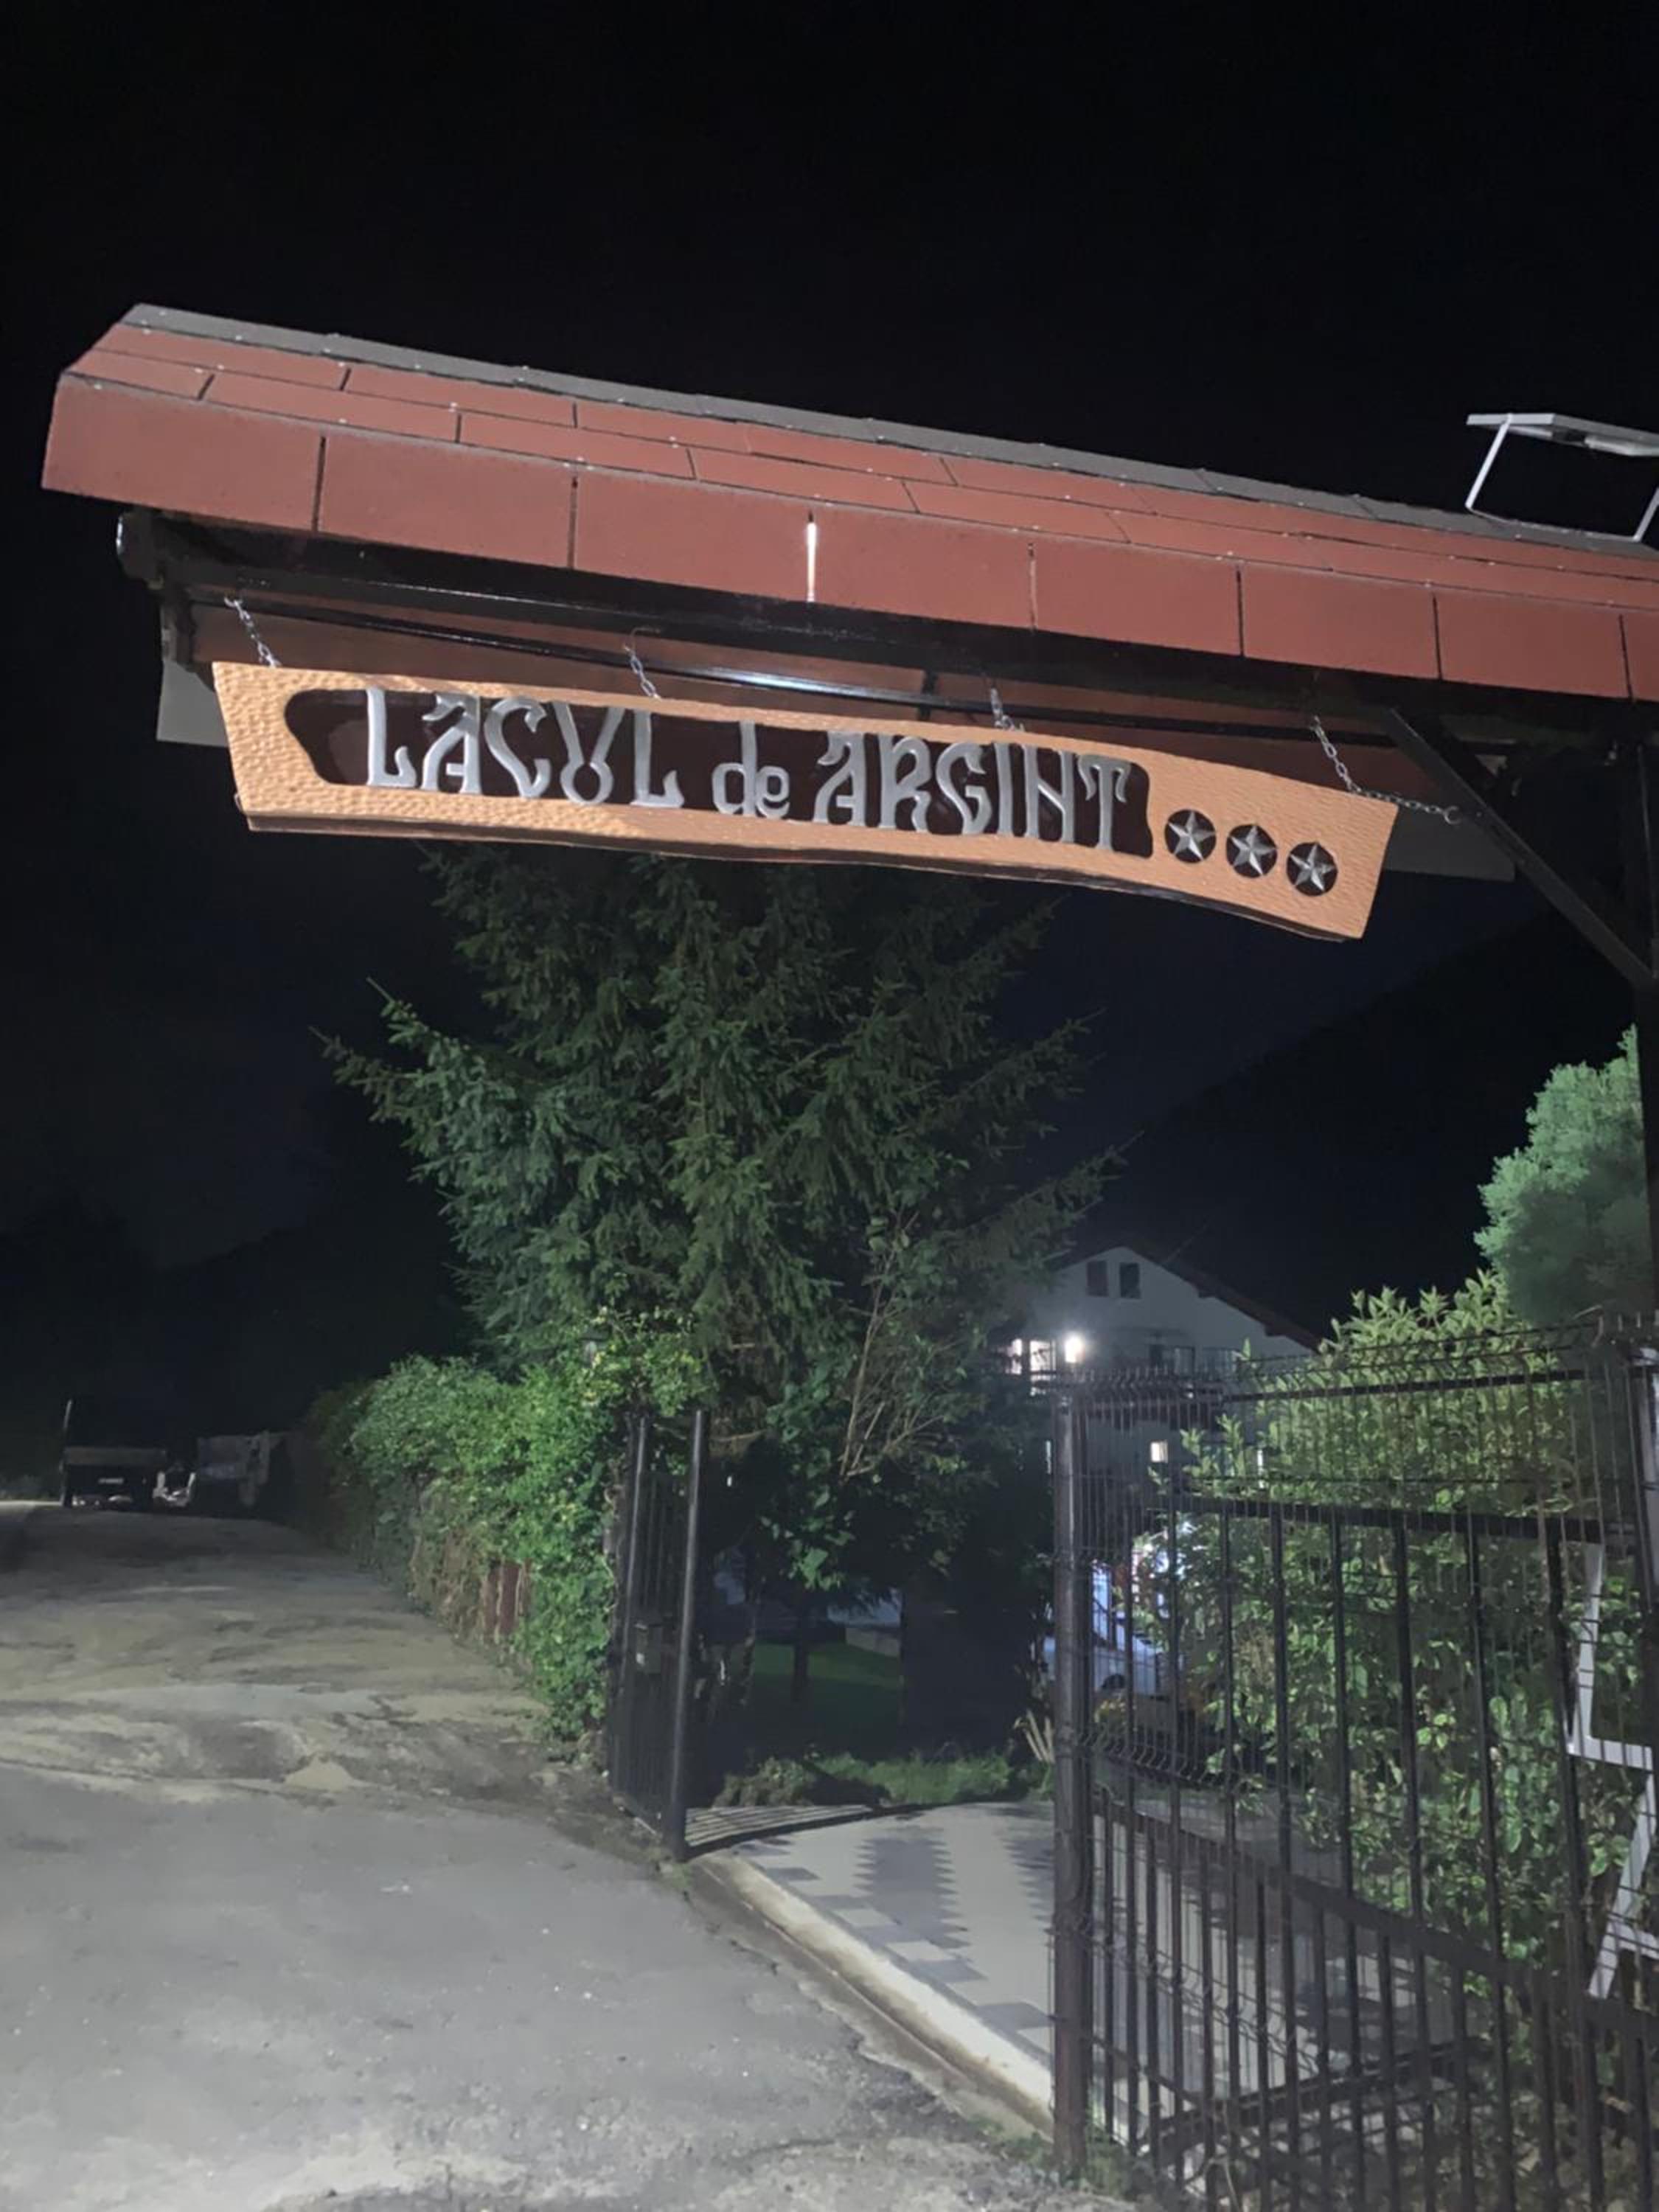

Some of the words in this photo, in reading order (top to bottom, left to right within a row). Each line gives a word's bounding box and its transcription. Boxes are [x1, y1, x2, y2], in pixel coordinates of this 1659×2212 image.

[366, 686, 684, 809] LACUL
[712, 720, 790, 819] de
[813, 729, 1132, 852] ARGINT
